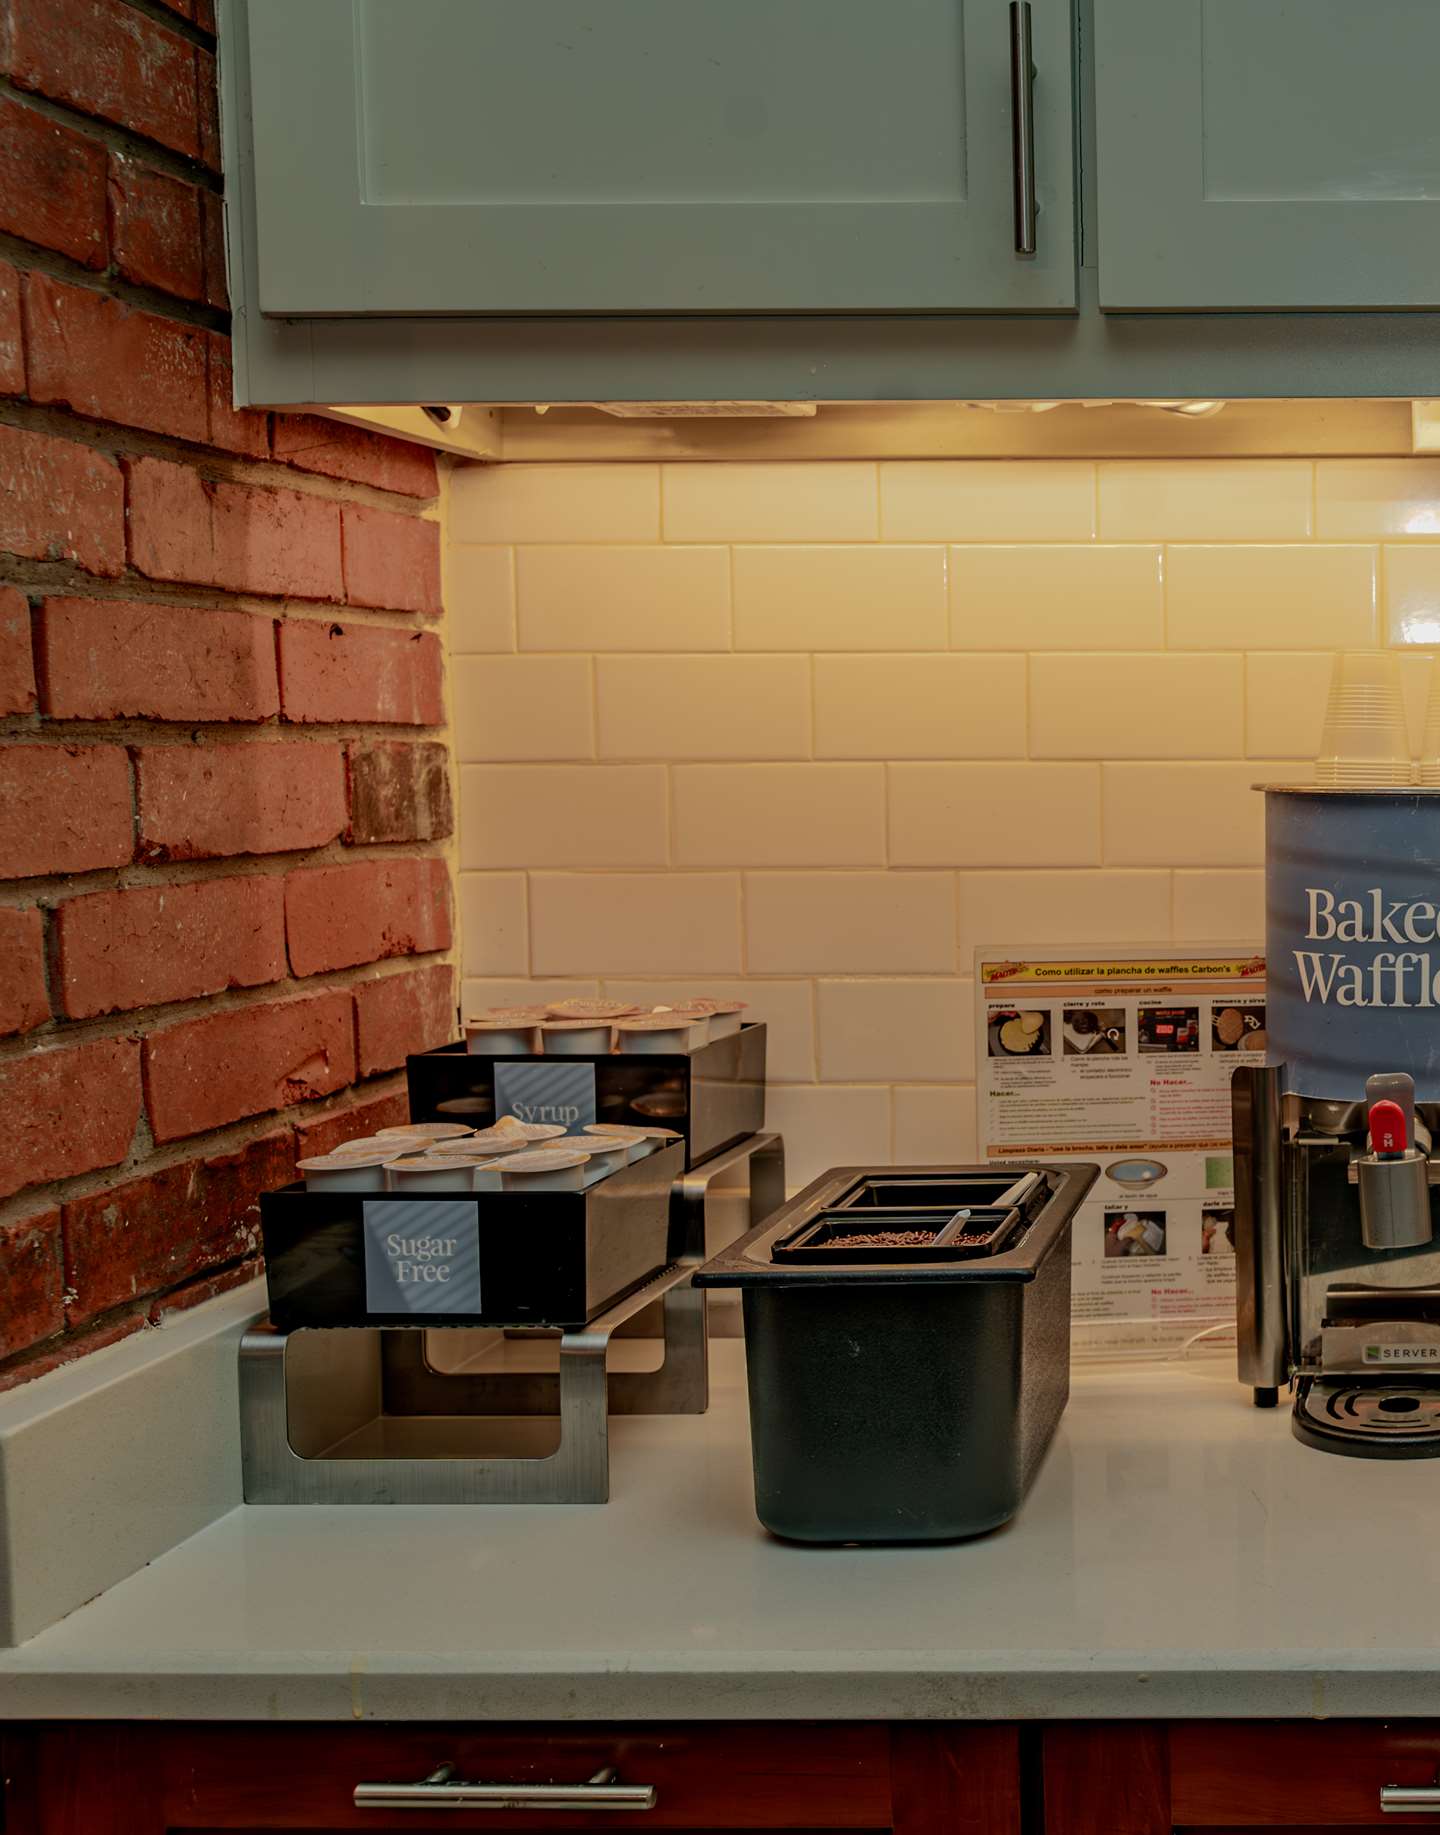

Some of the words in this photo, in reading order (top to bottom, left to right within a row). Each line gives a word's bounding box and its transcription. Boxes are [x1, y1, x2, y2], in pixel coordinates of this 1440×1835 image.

[1035, 968, 1062, 976] Como
[1064, 966, 1093, 976] utilizar
[1096, 966, 1105, 975] la
[1107, 965, 1142, 976] plancha
[1145, 966, 1155, 974] de
[1158, 965, 1189, 974] waffles
[1191, 965, 1231, 973] Carbon's
[1114, 987, 1140, 996] preparar
[511, 1102, 580, 1125] Syrup
[386, 1234, 457, 1262] Sugar
[396, 1261, 451, 1283] Free
[1383, 1348, 1438, 1358] SERVER
